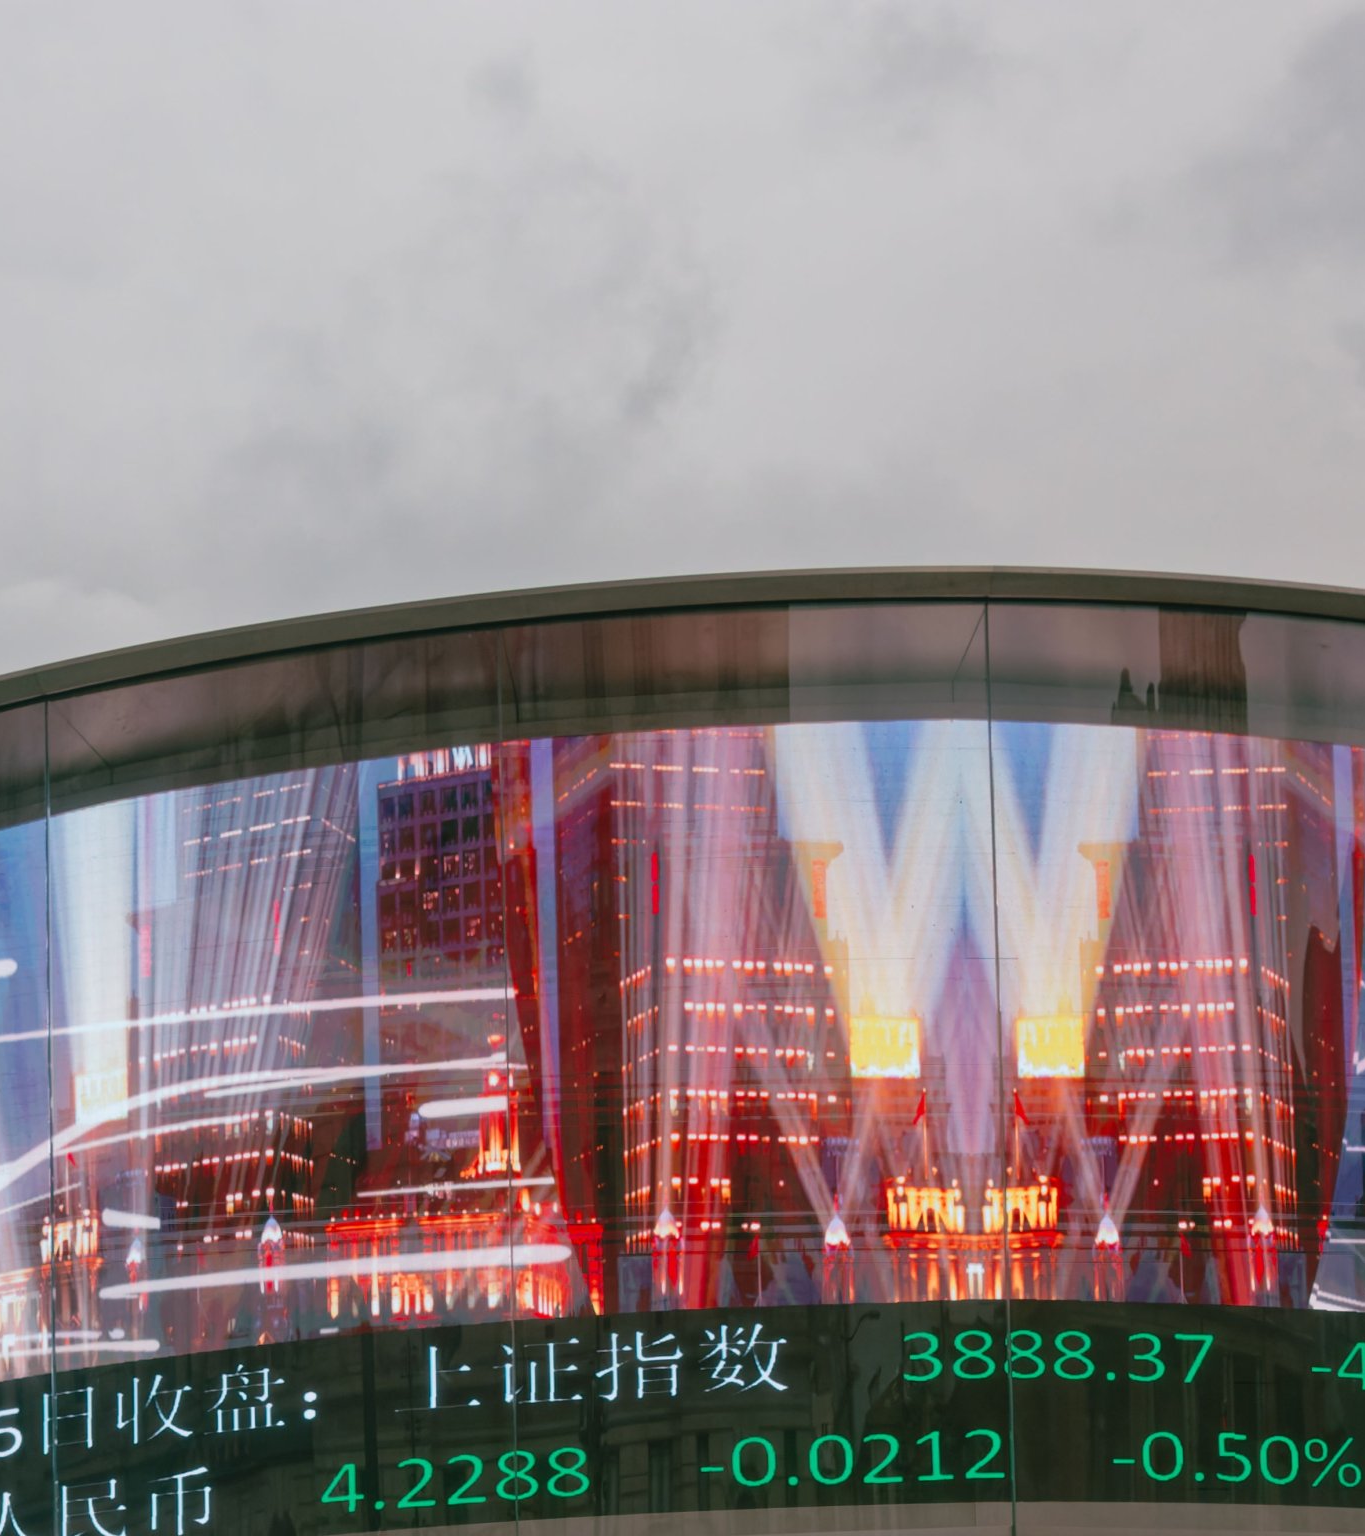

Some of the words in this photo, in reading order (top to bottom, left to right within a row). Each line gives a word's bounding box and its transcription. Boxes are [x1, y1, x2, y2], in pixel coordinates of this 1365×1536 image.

[394, 1322, 790, 1413] 上证指数
[902, 1329, 1215, 1384] 3888.37
[320, 1446, 591, 1514] 4.2288
[699, 1427, 1007, 1488] -0.0212
[1112, 1430, 1363, 1488] -0.50%
